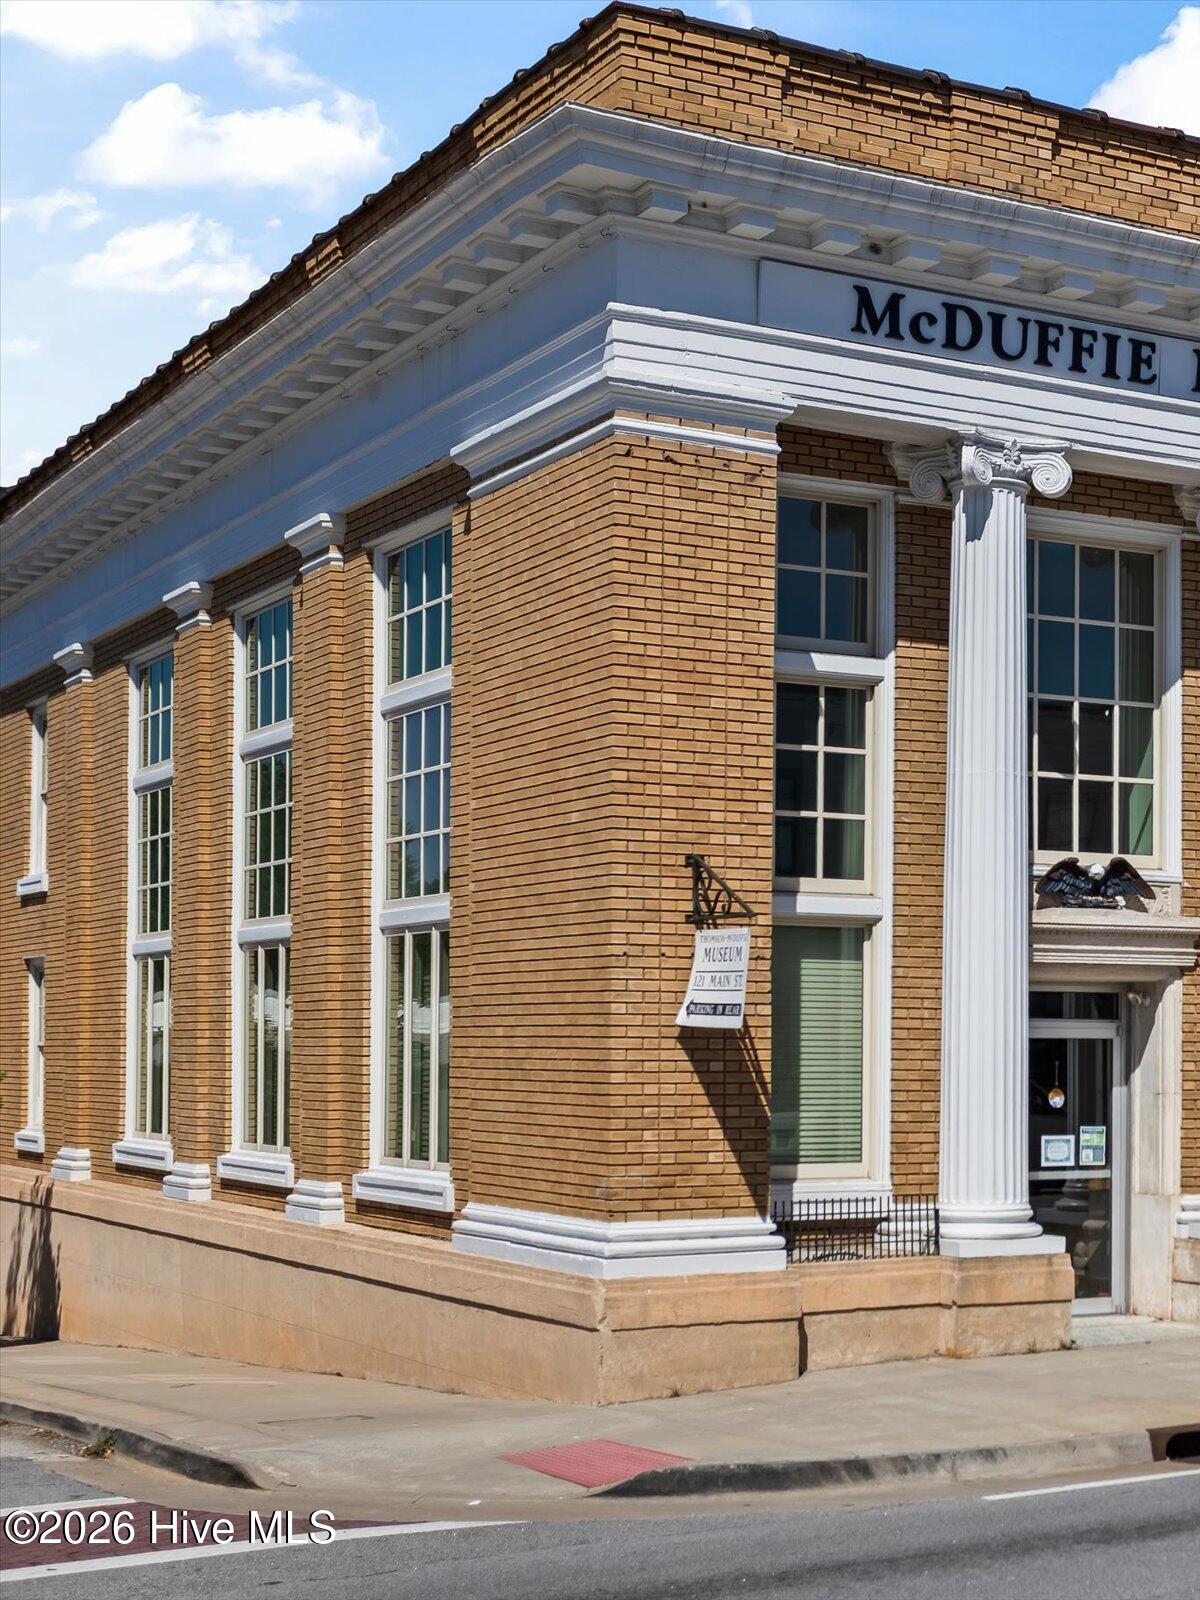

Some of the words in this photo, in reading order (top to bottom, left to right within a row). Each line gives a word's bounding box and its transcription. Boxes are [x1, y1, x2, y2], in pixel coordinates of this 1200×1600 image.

[850, 283, 1159, 385] McDUFFIE
[702, 946, 743, 963] MUSEUM
[693, 975, 705, 988] 121
[708, 974, 731, 987] MAIN
[734, 974, 743, 987] ST
[688, 1003, 714, 1014] PARKING
[715, 1004, 723, 1014] IN
